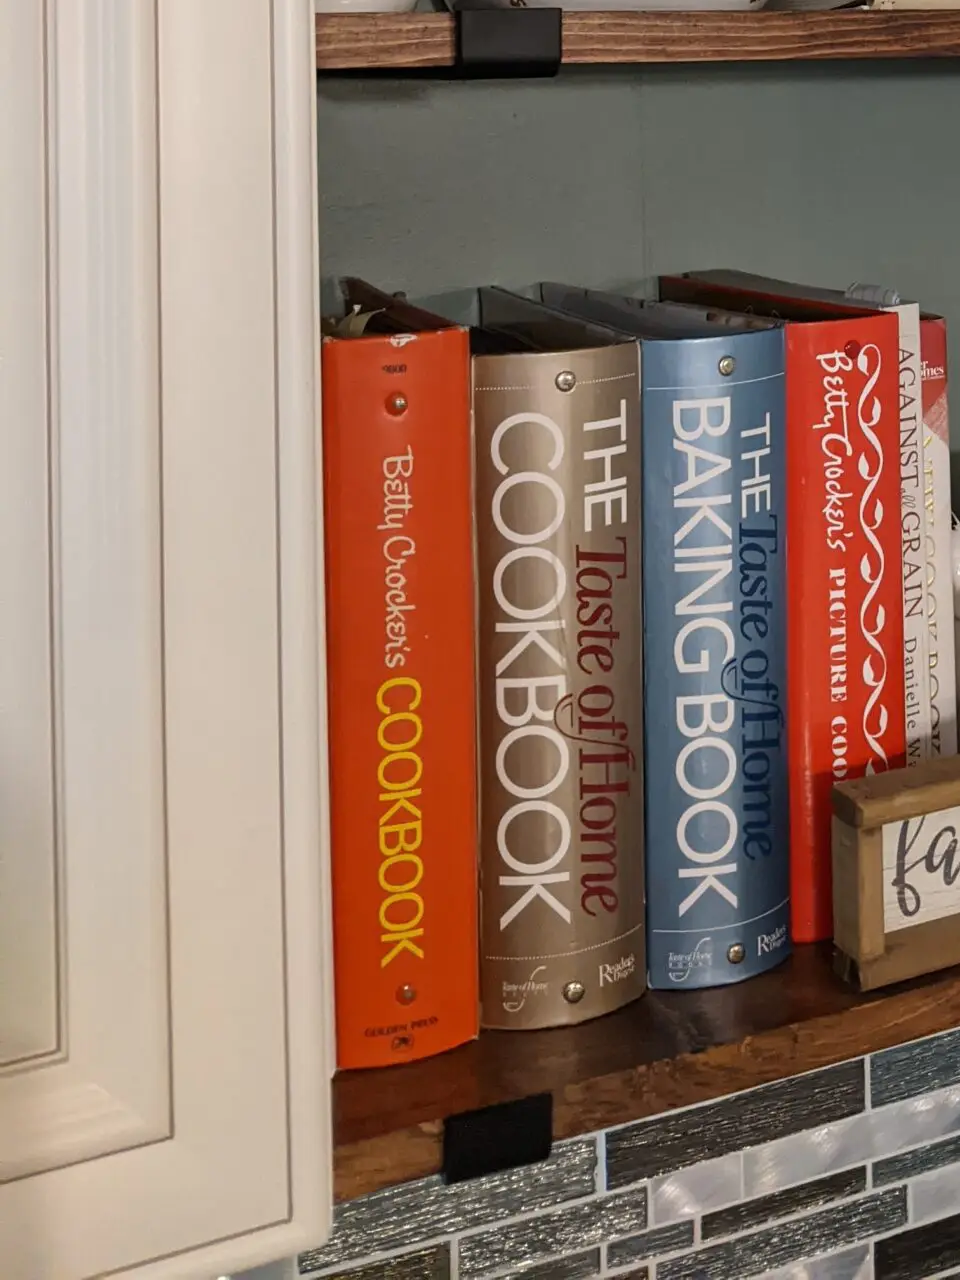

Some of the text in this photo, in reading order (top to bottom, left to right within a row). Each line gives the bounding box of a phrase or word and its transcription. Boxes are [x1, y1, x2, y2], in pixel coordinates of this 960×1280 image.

[812, 349, 854, 785] Betty Crocker's PICTURE COO
[899, 347, 919, 488] AGAINST
[902, 511, 923, 618] GRAIN
[375, 444, 425, 969] Betty Crocker's COOKBOOK
[491, 411, 572, 932] COOKBOOK
[575, 398, 632, 918] THE Taste of Home
[673, 395, 738, 918] BAKING BOOK
[738, 411, 781, 861] THE Taste of Home
[904, 638, 921, 729] Danielle
[599, 953, 636, 988] Reader's
[757, 924, 787, 957] Reader's
